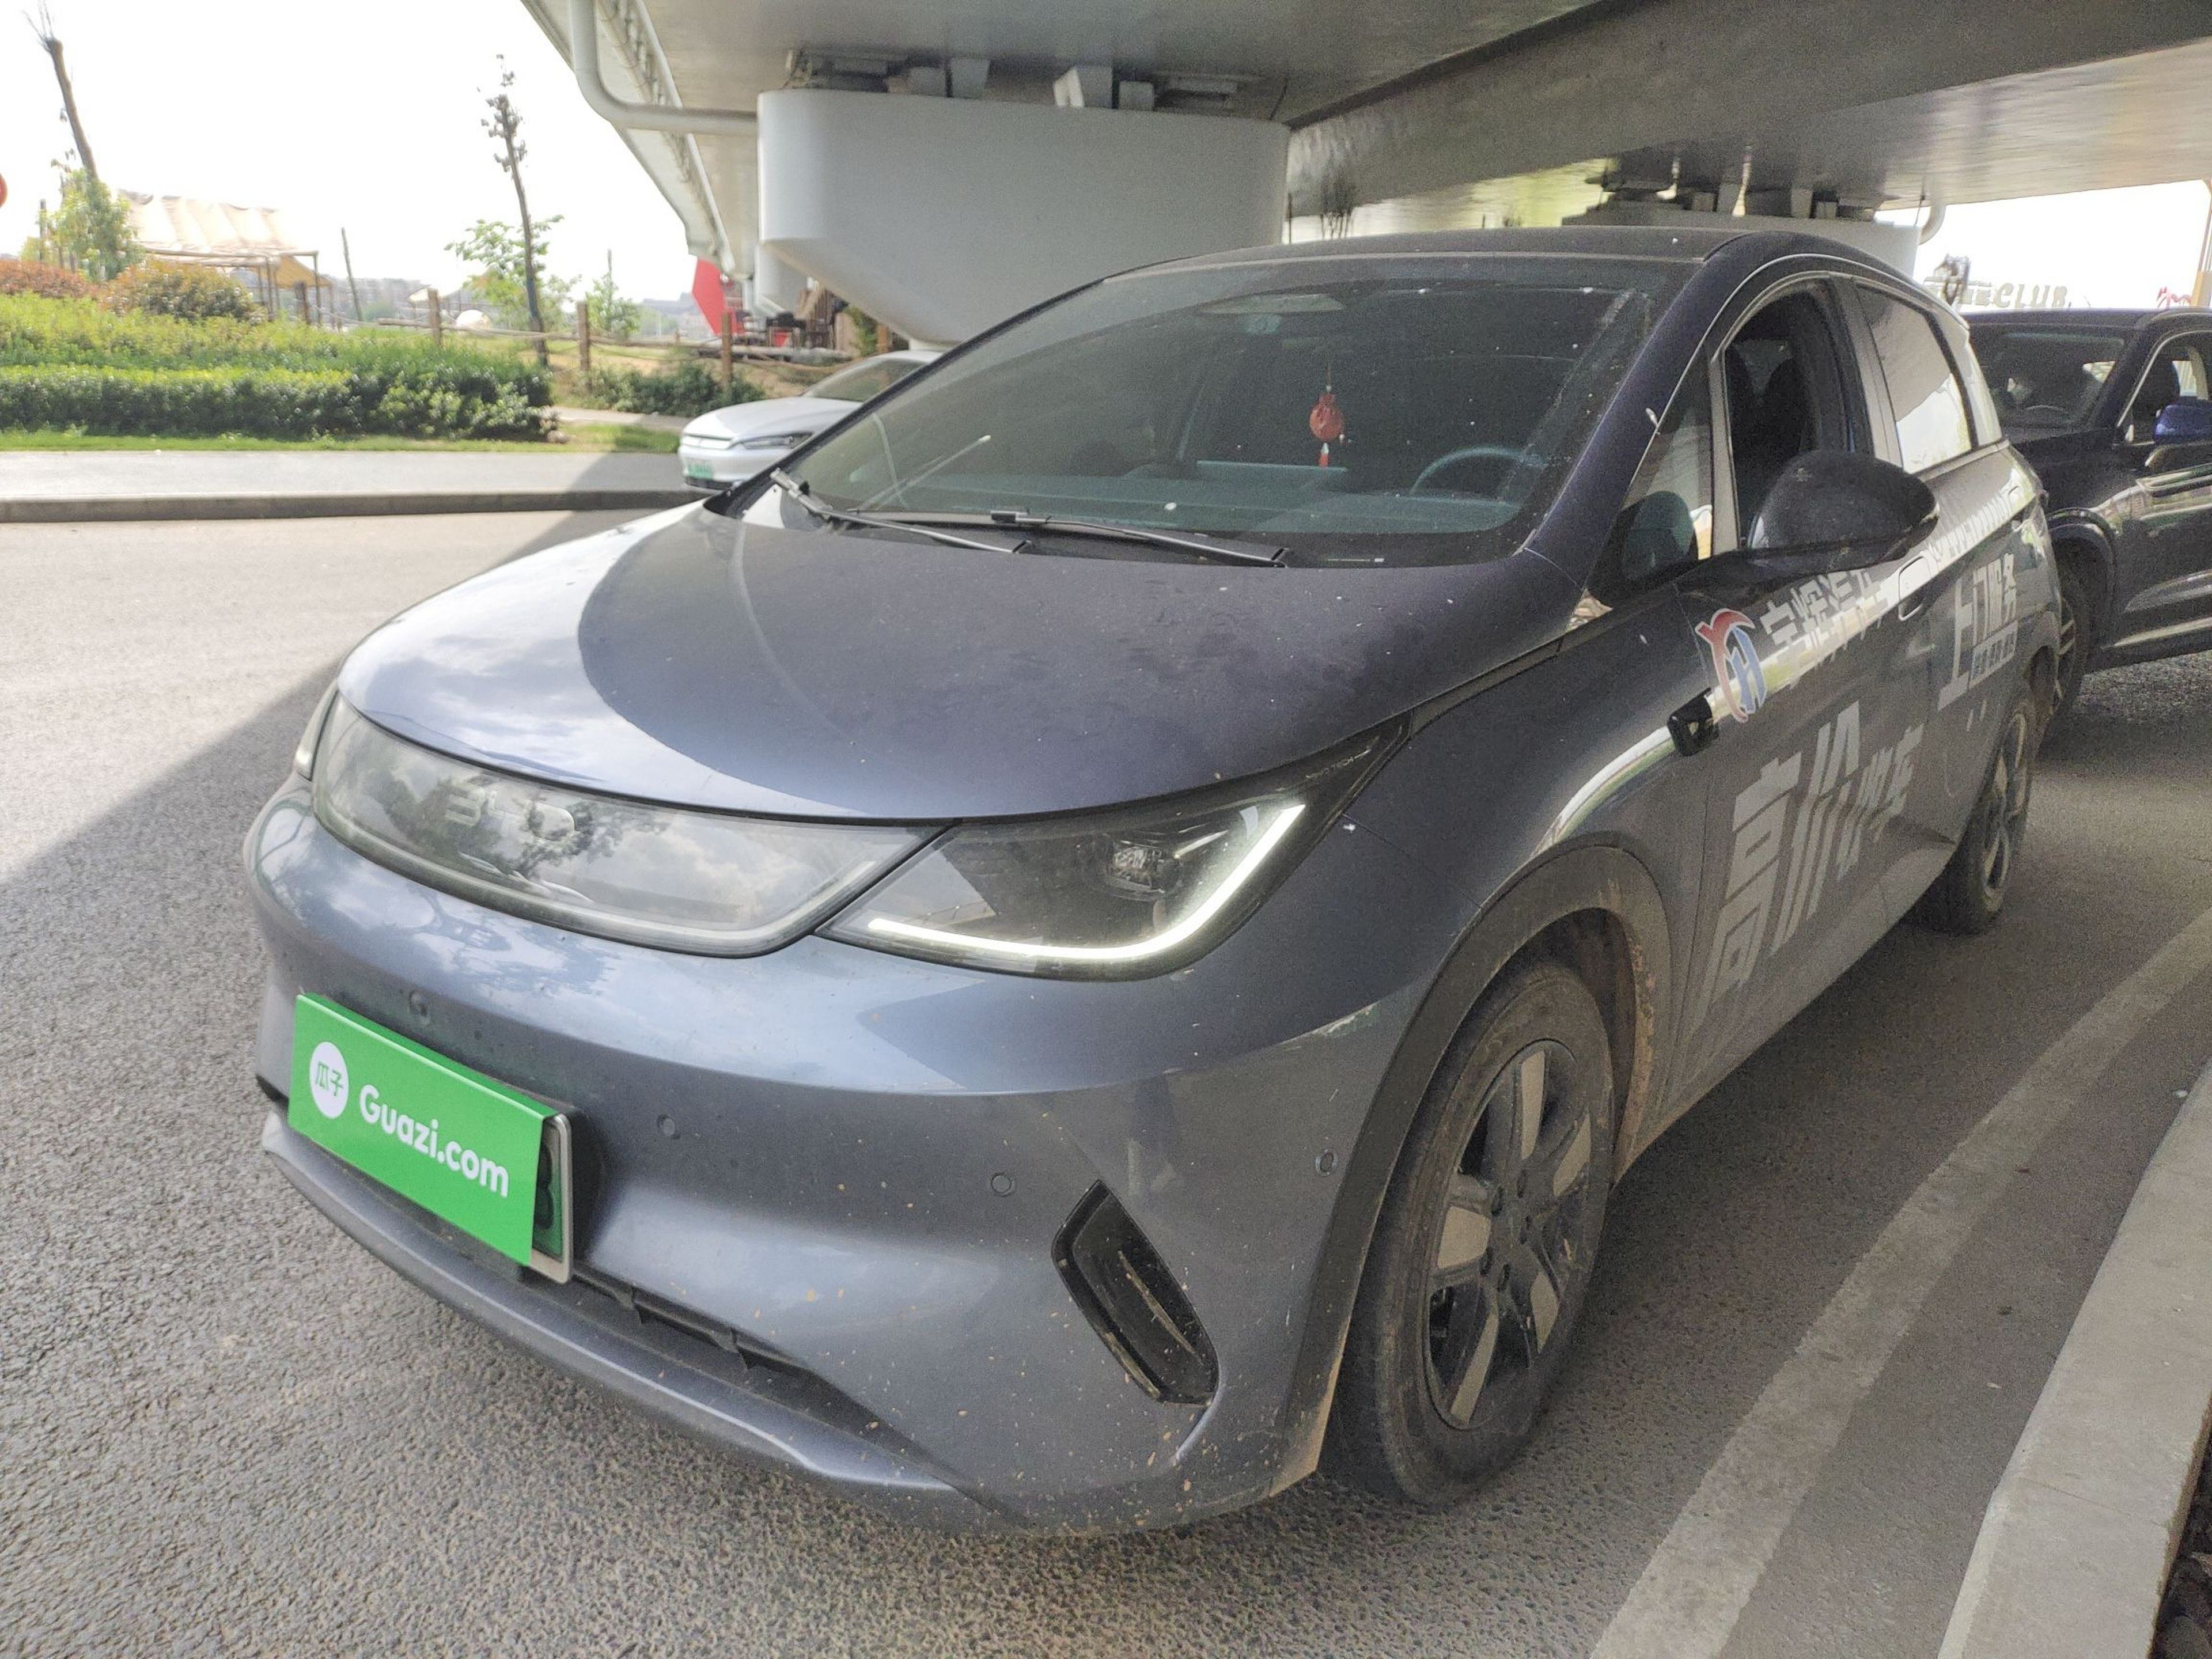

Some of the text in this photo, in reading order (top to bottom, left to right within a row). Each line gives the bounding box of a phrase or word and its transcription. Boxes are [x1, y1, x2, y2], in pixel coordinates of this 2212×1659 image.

[1993, 282, 2068, 308] CLUB
[315, 1060, 344, 1097] 瓜子
[359, 1084, 509, 1198] Guazi.com
